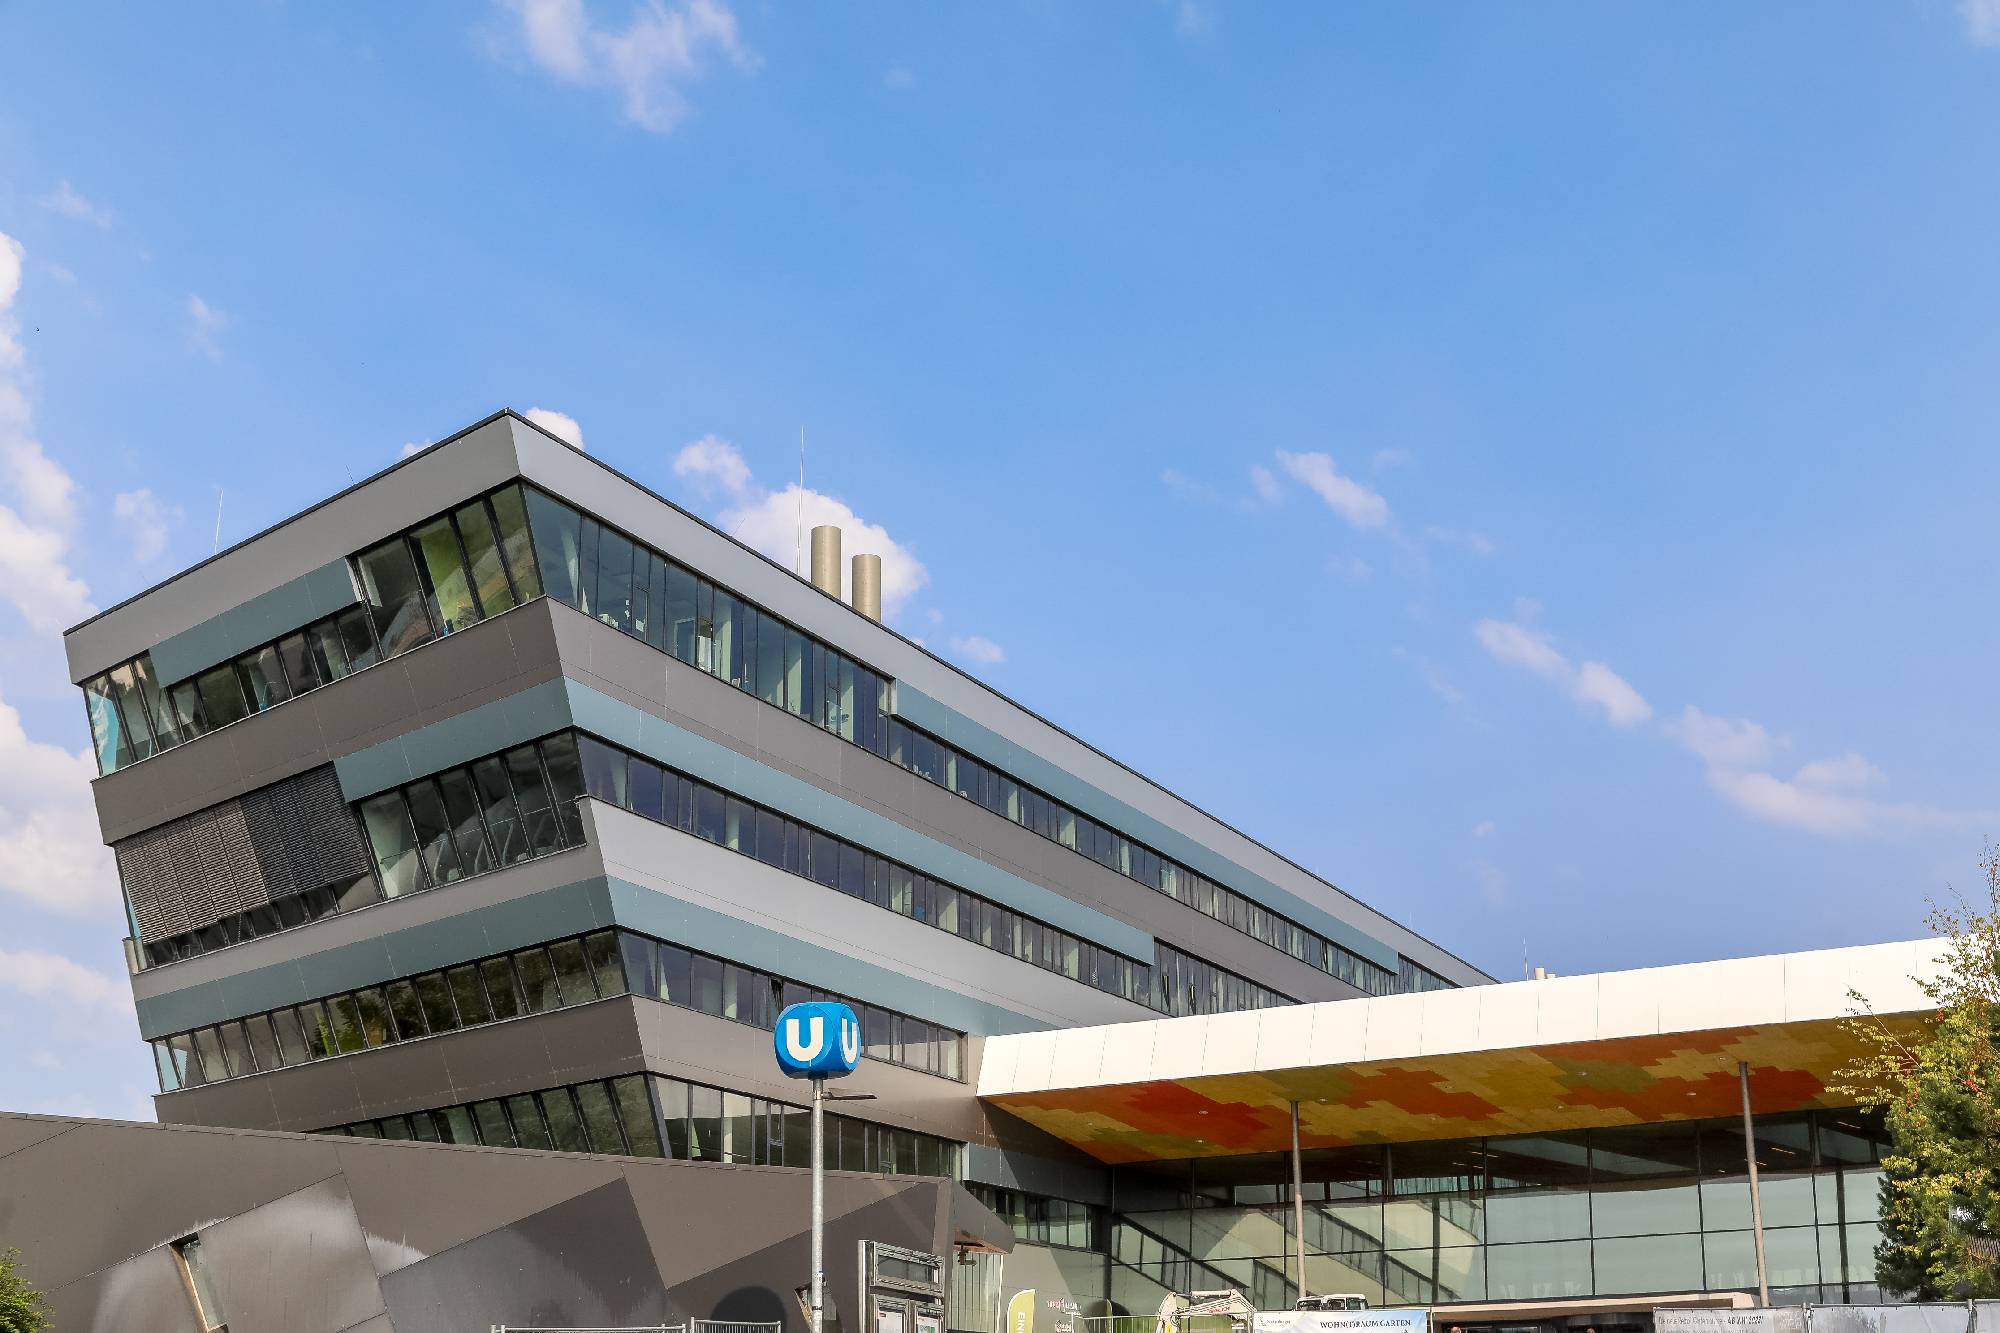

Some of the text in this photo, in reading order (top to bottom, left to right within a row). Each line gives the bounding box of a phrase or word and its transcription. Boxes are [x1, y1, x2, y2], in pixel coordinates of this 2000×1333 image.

[786, 1017, 823, 1061] U
[842, 1018, 857, 1064] U
[1016, 1312, 1025, 1333] EIN
[1380, 1319, 1411, 1327] GARTEN
